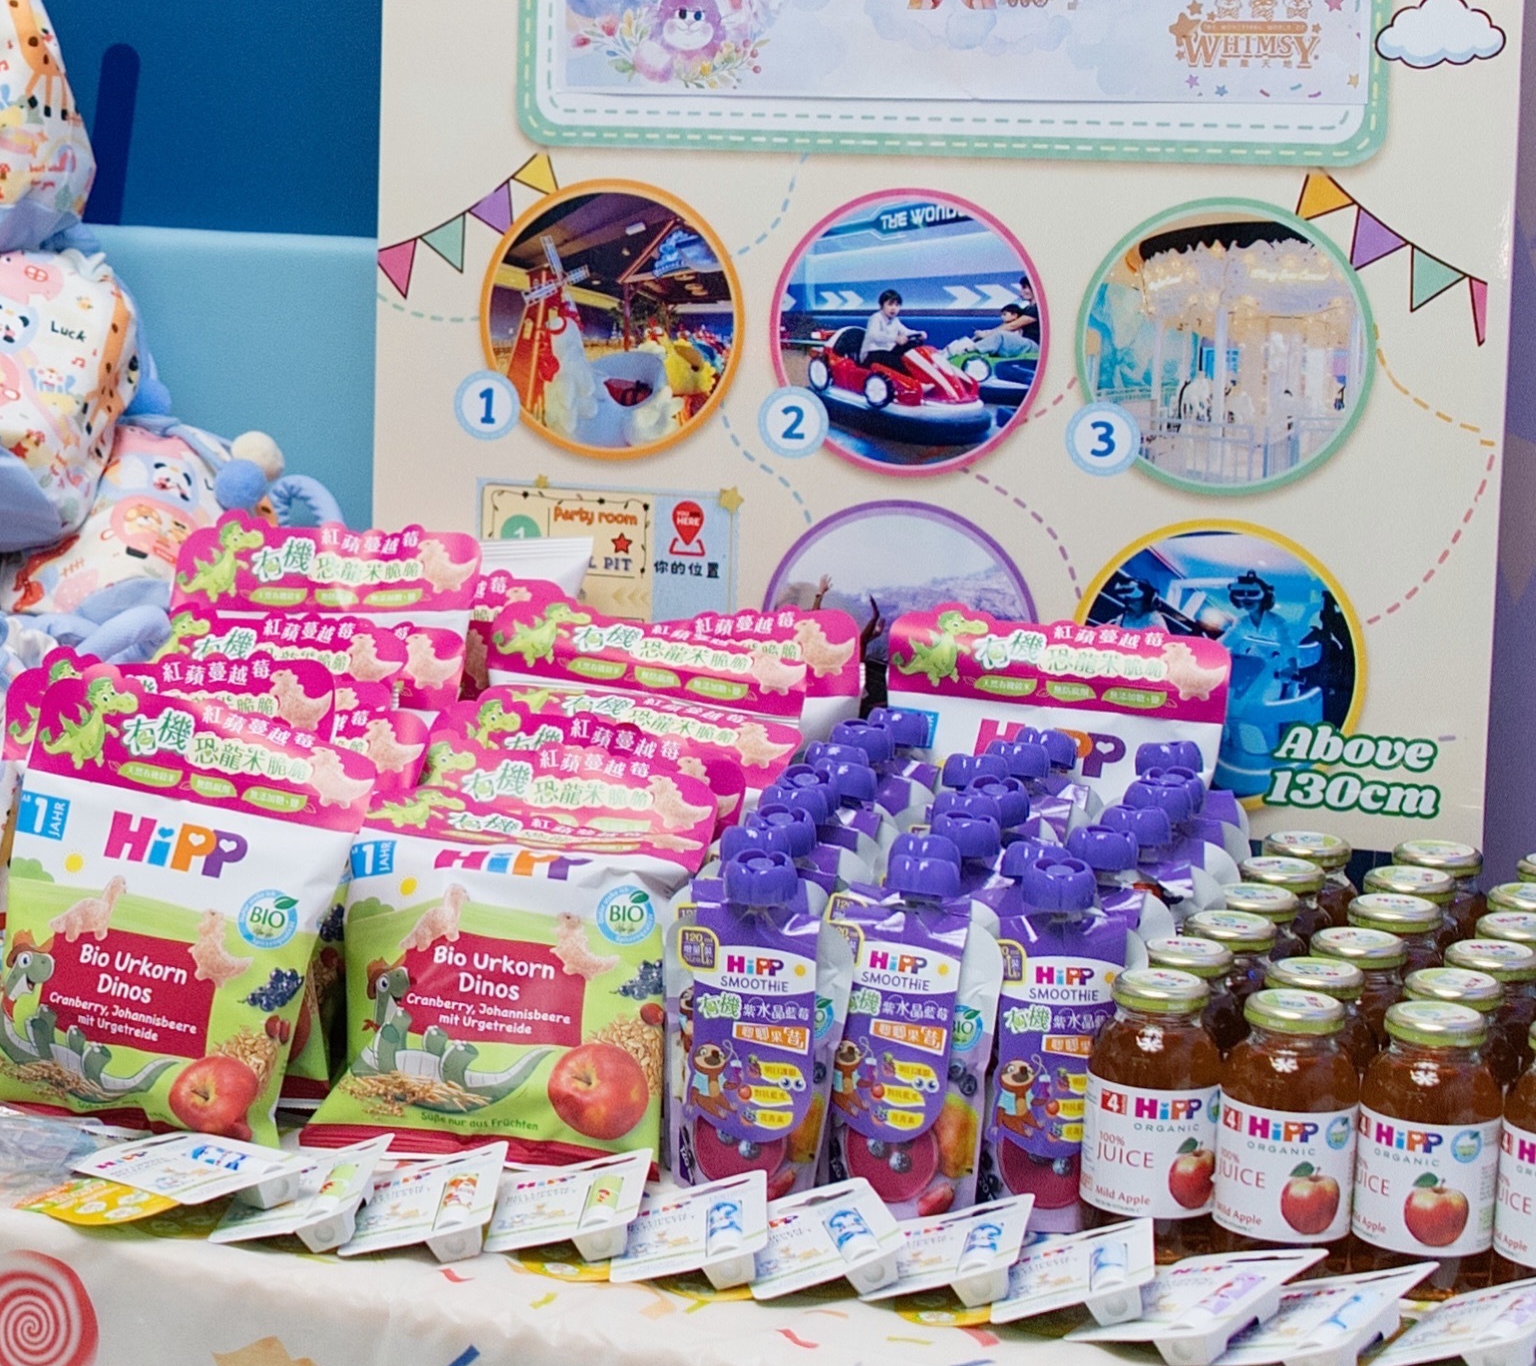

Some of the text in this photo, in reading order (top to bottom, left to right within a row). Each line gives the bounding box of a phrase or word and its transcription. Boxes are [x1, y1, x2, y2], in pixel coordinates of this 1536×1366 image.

[1183, 34, 1321, 69] WHIMSY
[50, 321, 88, 343] Luck
[479, 386, 496, 425] 1
[782, 405, 806, 440] 2
[1090, 421, 1117, 457] 3
[553, 506, 638, 526] Party room
[676, 517, 700, 527] HERE
[321, 528, 419, 554] 紅蘋蔓越莓
[253, 538, 314, 580] 有機
[604, 557, 632, 572] PIT
[654, 560, 719, 579] 你的位置
[575, 626, 640, 651] 有機
[975, 629, 1047, 668] 有機
[1054, 625, 1164, 650] 紅蘋蔓越莓
[162, 661, 272, 688] 紅蘋蔓越莓
[203, 705, 313, 748] 紅蘋蔓越莓
[570, 719, 681, 760] 紅蘋蔓越莓
[125, 710, 309, 782] 有機 恐龍米脆脆
[1274, 726, 1435, 770] Above
[539, 750, 650, 778] 紅蘋蔓越莓
[463, 762, 531, 801] 有機
[1266, 771, 1440, 817] 130cm
[33, 798, 49, 833] 1
[50, 802, 66, 837] JAHR
[104, 810, 248, 879] HiPP
[379, 841, 393, 873] JAHR
[363, 844, 375, 876] 1
[250, 906, 286, 929] BIO
[610, 905, 644, 923] BIO
[79, 944, 188, 985] Bio Urkorn
[434, 945, 555, 979] Bio Urkorn
[727, 955, 784, 977] HiPP
[869, 950, 928, 975] HiPP
[1036, 966, 1095, 985] HiPP
[97, 973, 152, 1003] Dinos
[459, 972, 520, 1000] Dinos
[49, 992, 197, 1034] Cranberry, Johannisbeere
[406, 992, 571, 1025] Cranberry, Johannisbeere
[697, 992, 742, 1019] 有機
[1005, 1006, 1109, 1033] 有機 紫水晶藍
[77, 1014, 159, 1042] mit Urgetreide
[439, 1012, 532, 1037] mit Urgetreide
[1107, 1094, 1203, 1120] 4 HiPP
[449, 1116, 468, 1126] nur
[491, 1116, 539, 1131] Früchten
[1134, 1123, 1200, 1133] ORGANIC
[1248, 1115, 1319, 1144] HiPP
[1099, 1130, 1125, 1147] 100%
[1246, 1140, 1316, 1157] ORGANIC
[1375, 1122, 1443, 1154] HiPP
[1097, 1142, 1154, 1169] JUICE
[1374, 1147, 1440, 1167] ORGANIC
[1218, 1160, 1267, 1189] JUICE
[1355, 1167, 1390, 1198] UICE
[1095, 1184, 1117, 1201] Mild
[1118, 1192, 1152, 1207] Apple
[1497, 1188, 1533, 1216] UICE
[1233, 1209, 1263, 1226] Apple
[1362, 1216, 1387, 1234] Apple
[1503, 1234, 1528, 1252] Apple
